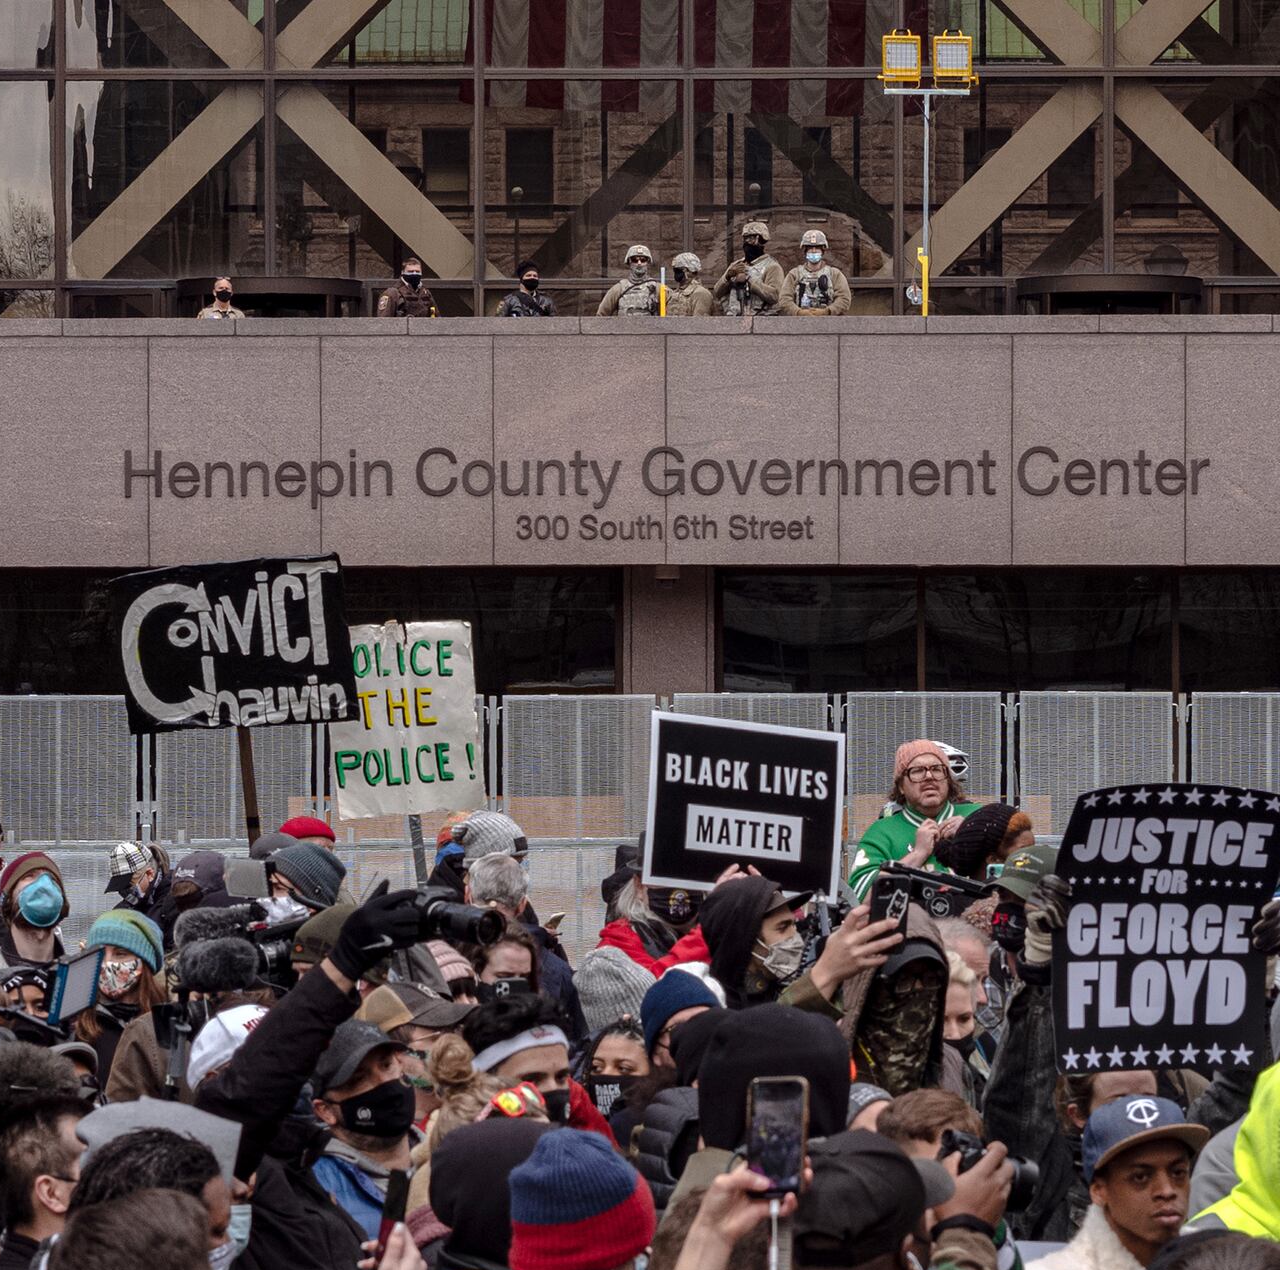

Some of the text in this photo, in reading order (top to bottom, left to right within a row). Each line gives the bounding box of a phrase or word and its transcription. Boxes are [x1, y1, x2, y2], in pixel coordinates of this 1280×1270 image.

[123, 446, 1211, 510] Hennepin County Government Center
[516, 513, 814, 541] 300 South 6th Street
[351, 639, 455, 680] OLICE
[357, 687, 438, 730] THE
[665, 752, 829, 801] BLACK LIVES
[696, 814, 793, 853] MATTER
[1072, 817, 1275, 868] JUSTICE
[1140, 868, 1189, 895] FOR
[1066, 902, 1255, 956] GEORGE
[1067, 959, 1247, 1029] FLOYD
